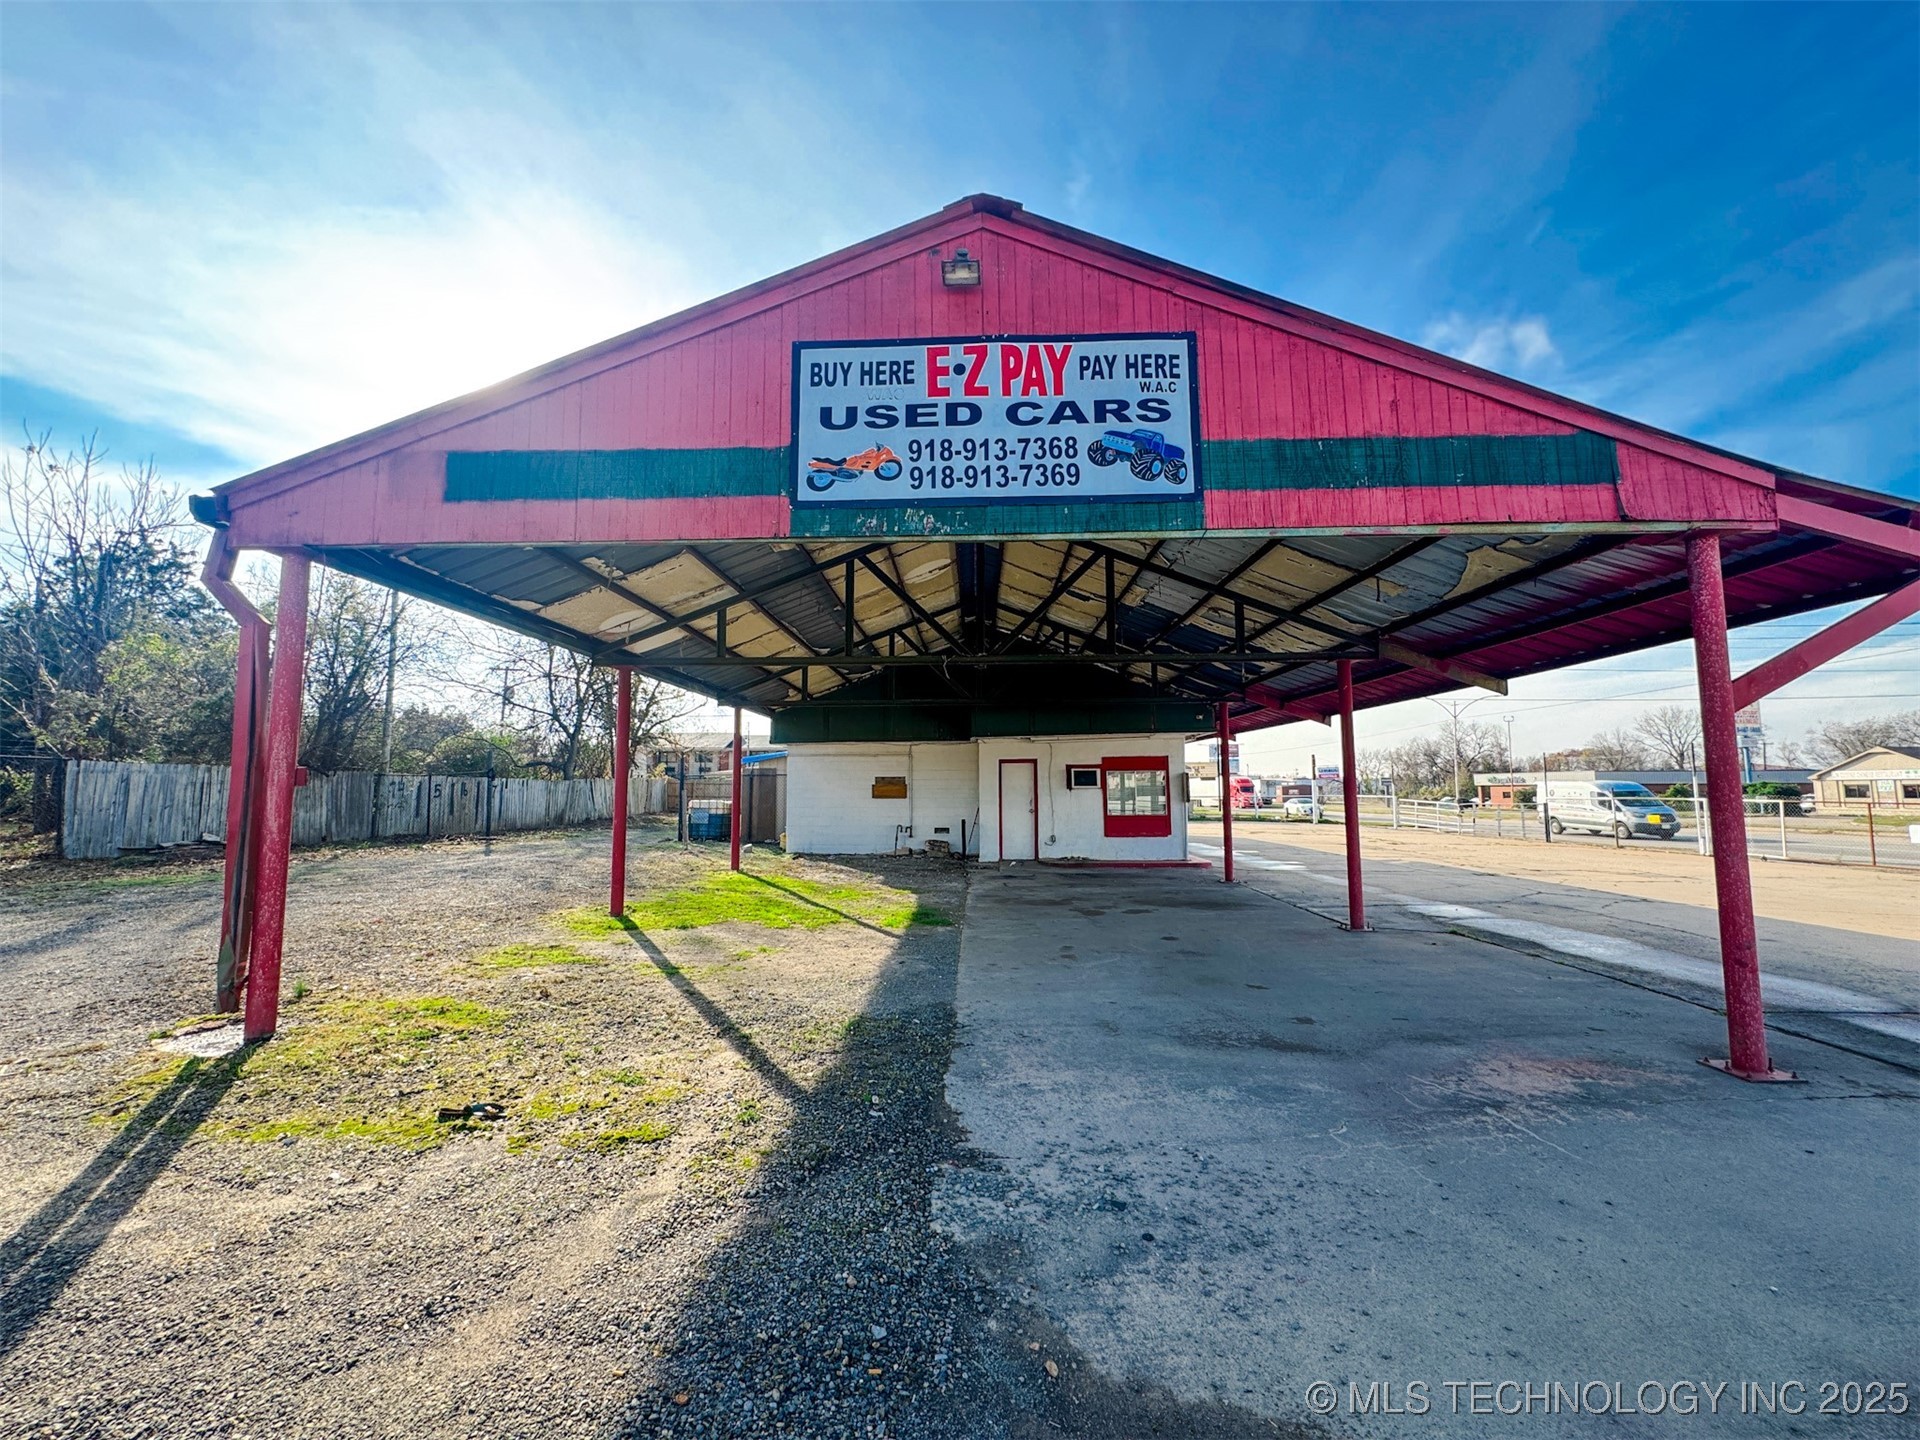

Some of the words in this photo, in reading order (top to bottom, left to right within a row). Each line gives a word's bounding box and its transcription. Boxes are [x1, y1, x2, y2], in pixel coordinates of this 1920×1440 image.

[810, 361, 853, 388] BUY
[860, 359, 915, 386] HERE
[1000, 343, 1073, 397] PAY
[1079, 354, 1118, 381] PAY
[1125, 353, 1181, 380] HERE
[1139, 381, 1177, 393] W.A.C
[819, 402, 983, 431] USED
[1005, 397, 1172, 426] CARS
[907, 435, 1079, 463] 918-913-7368
[909, 462, 1081, 490] 918-913-7369
